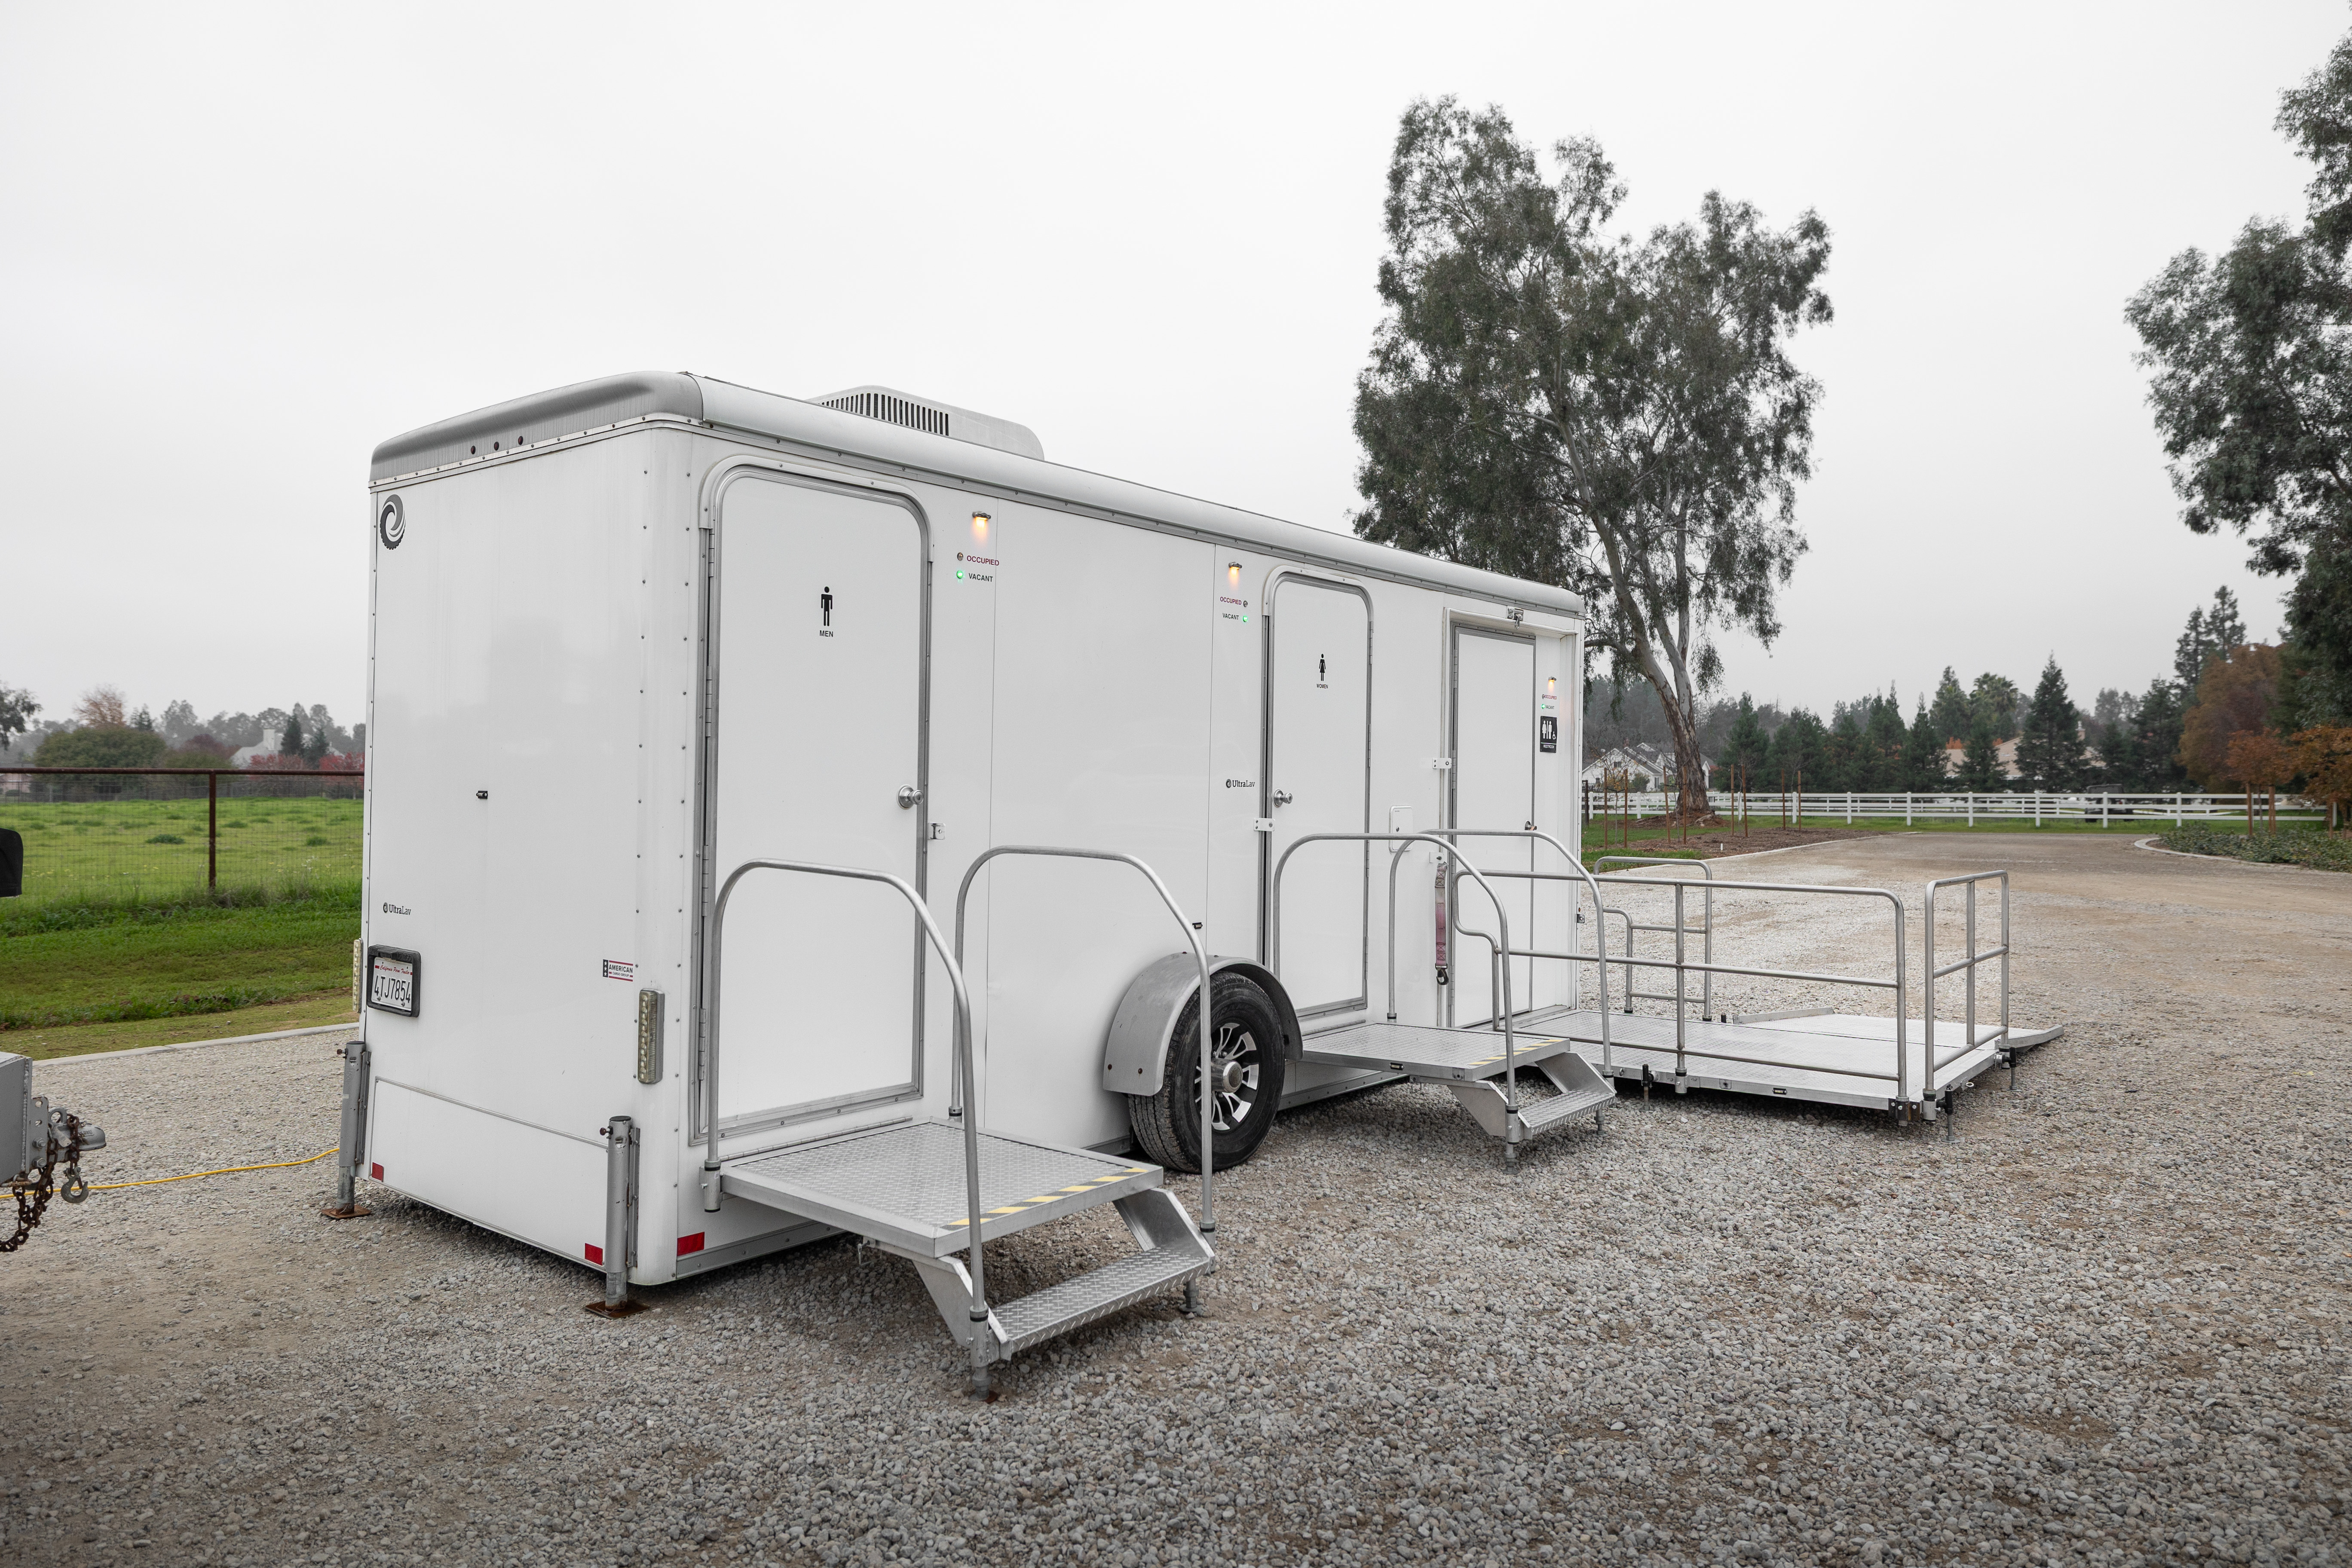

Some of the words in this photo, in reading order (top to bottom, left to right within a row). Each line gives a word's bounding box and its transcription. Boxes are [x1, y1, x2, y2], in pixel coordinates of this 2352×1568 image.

[967, 555, 999, 566] OCCUPIED
[968, 573, 993, 582] VACANT
[1220, 597, 1242, 605] OCCUPIED
[389, 904, 411, 915] UltraLav
[609, 964, 633, 973] AMERICAN
[374, 975, 410, 1003] 4TJ7854
